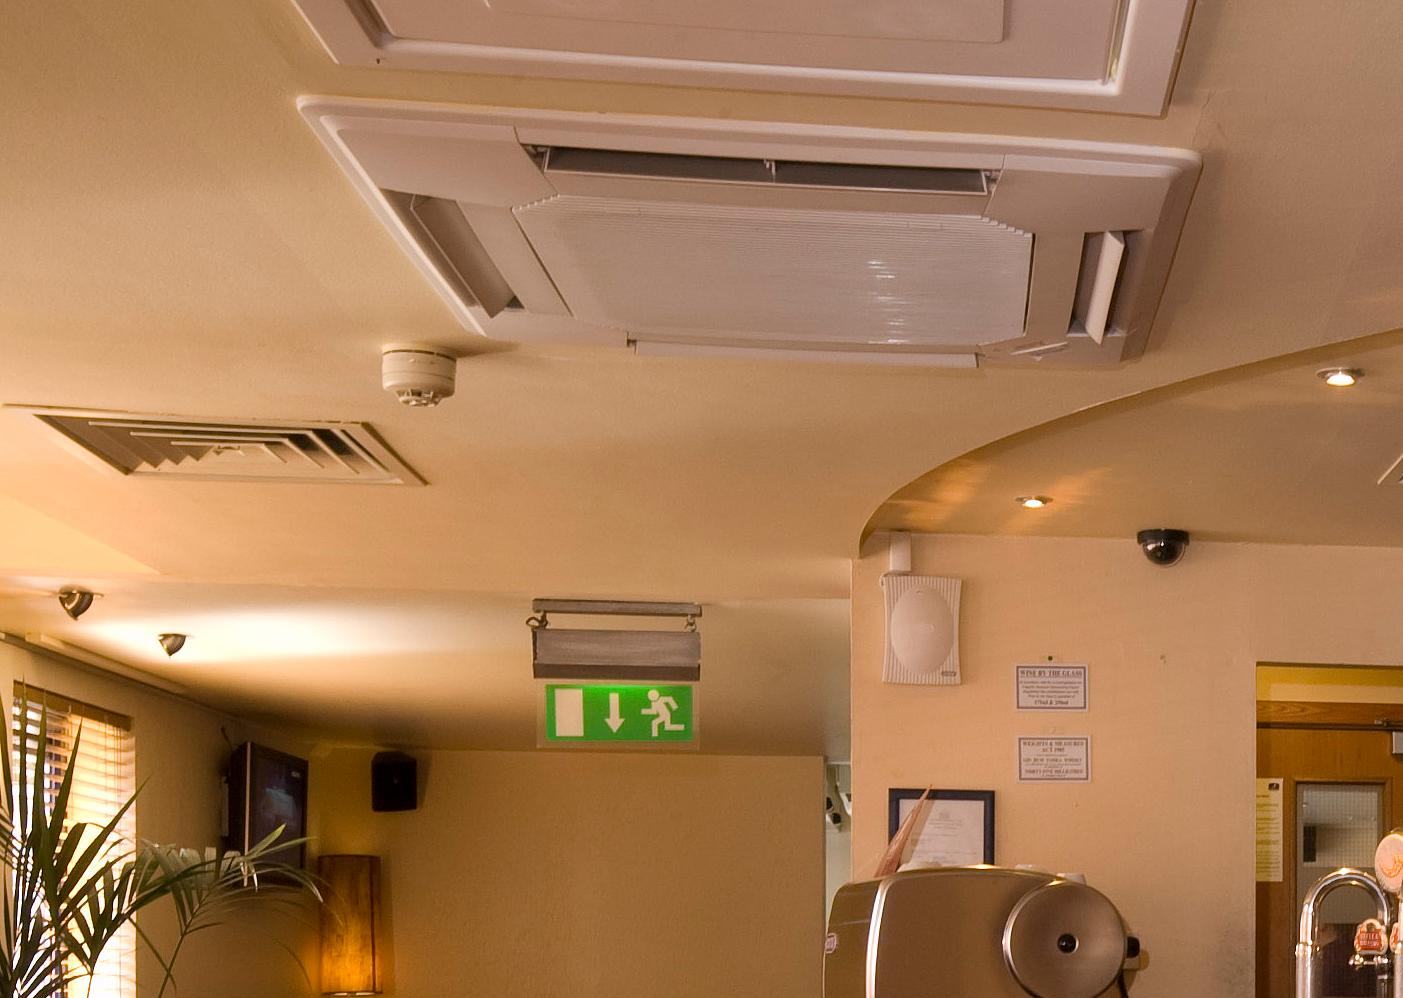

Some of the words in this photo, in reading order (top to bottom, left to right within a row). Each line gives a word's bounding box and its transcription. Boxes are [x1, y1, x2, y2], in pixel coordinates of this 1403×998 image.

[1020, 669, 1036, 678] WINE
[1038, 669, 1046, 678] BY
[1048, 669, 1060, 678] THE
[1062, 669, 1082, 678] GLASS
